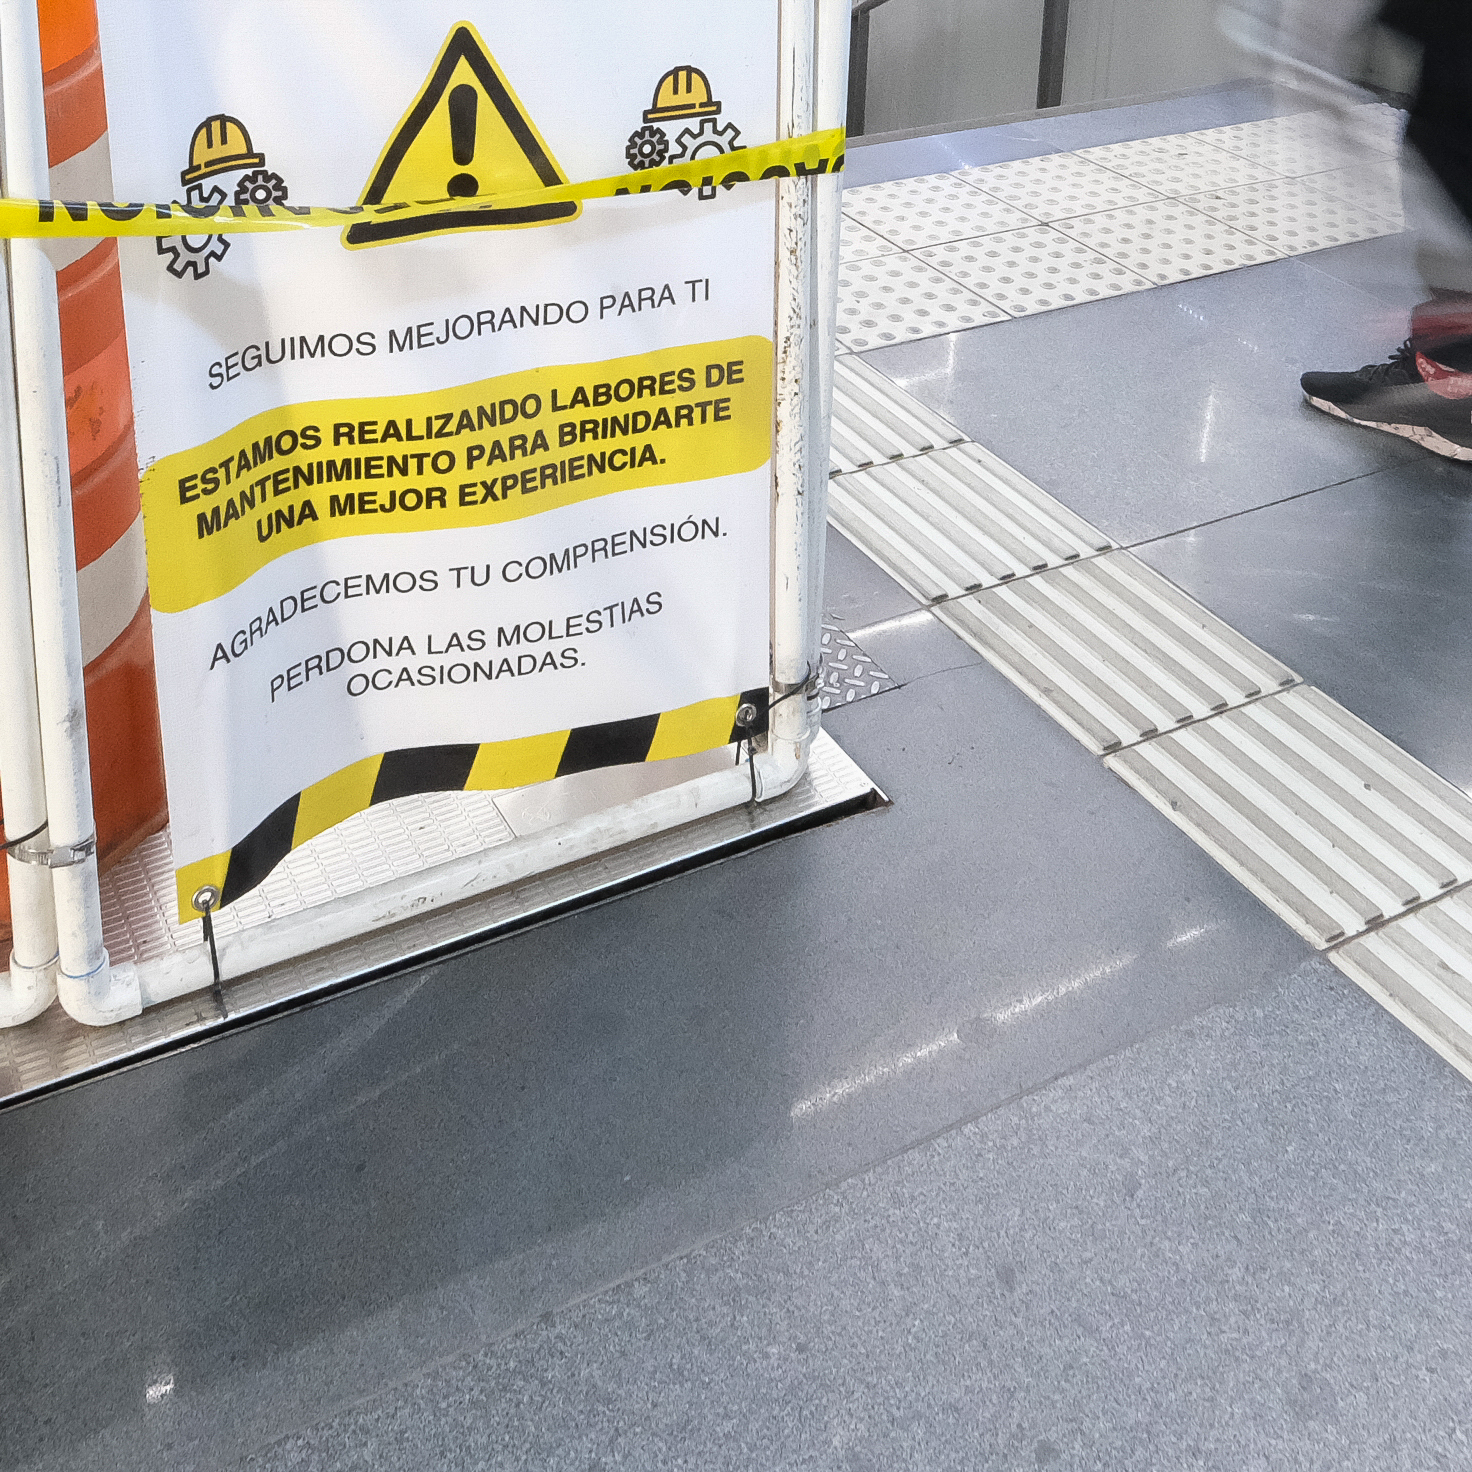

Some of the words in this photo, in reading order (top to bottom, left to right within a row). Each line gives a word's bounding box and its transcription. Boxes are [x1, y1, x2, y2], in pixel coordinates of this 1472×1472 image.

[208, 331, 377, 391] SEGUIMOS
[388, 300, 589, 354] MEJORANDO
[599, 283, 676, 320] PARA
[684, 278, 710, 303] TI
[178, 425, 322, 505] ESTAMOS
[333, 393, 542, 446] REALIZANDO
[551, 367, 696, 413] LABORES
[705, 360, 745, 388] DE
[196, 450, 456, 539] MANTENIMIENTO
[466, 429, 550, 470] PARA
[558, 397, 731, 448] BRINDARTE
[256, 499, 319, 543] UNA
[329, 486, 447, 518] MEJOR
[458, 443, 666, 507] EXPERIENCIA.
[209, 569, 439, 670] AGRADECEMOS
[448, 564, 491, 589] TU
[501, 514, 728, 583] COMPRENSIÓN.
[271, 635, 416, 703] PERDONA
[427, 628, 486, 655] LAS
[497, 591, 664, 648] MOLESTIAS
[346, 647, 586, 697] OCASIONADAS.
